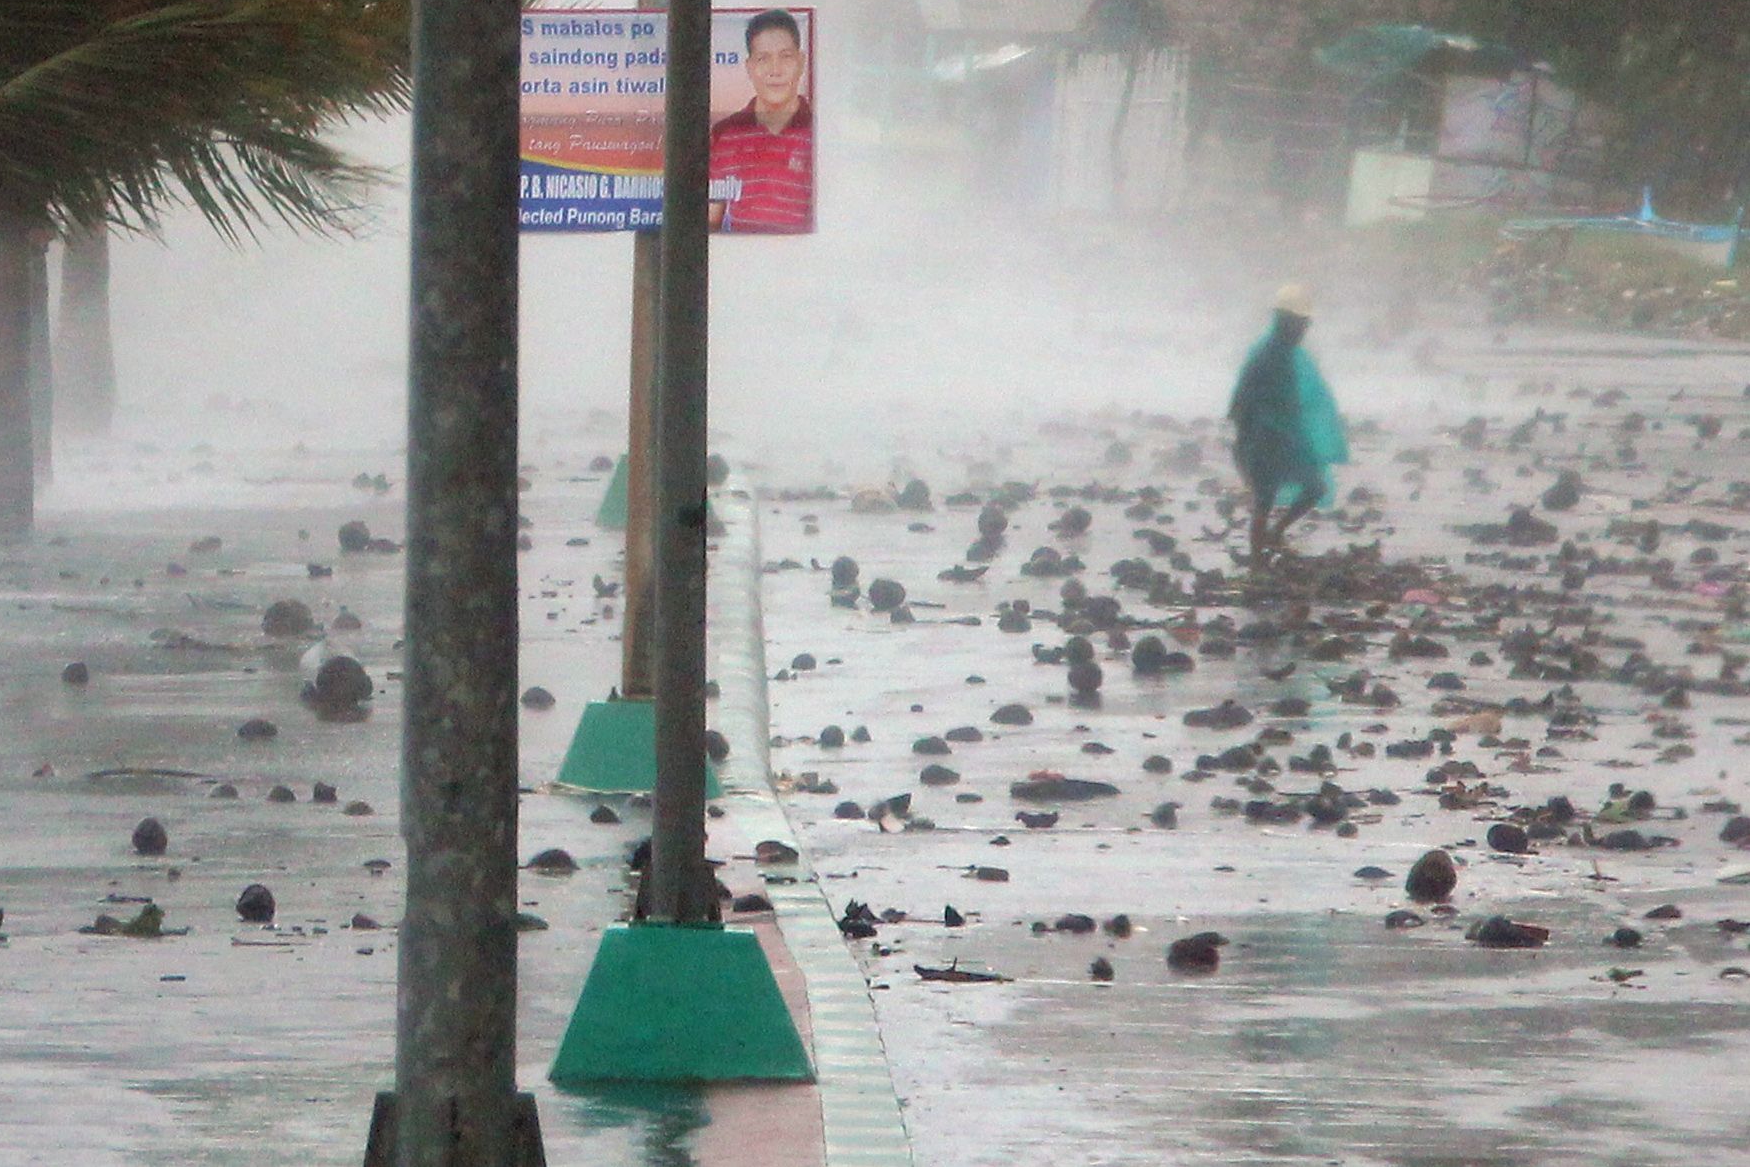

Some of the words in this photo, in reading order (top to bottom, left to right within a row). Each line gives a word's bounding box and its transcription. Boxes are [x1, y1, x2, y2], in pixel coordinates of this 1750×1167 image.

[541, 19, 624, 36] mabalos
[631, 22, 654, 40] po
[529, 48, 618, 69] saindong
[625, 48, 667, 67] pad
[521, 78, 561, 94] orta
[569, 78, 609, 94] asin
[616, 78, 665, 94] tiwal
[546, 174, 597, 199] NICASIO
[614, 175, 664, 199] BARRIO
[519, 207, 563, 225] lected
[567, 208, 626, 229] Punong
[629, 208, 664, 225] Bara
